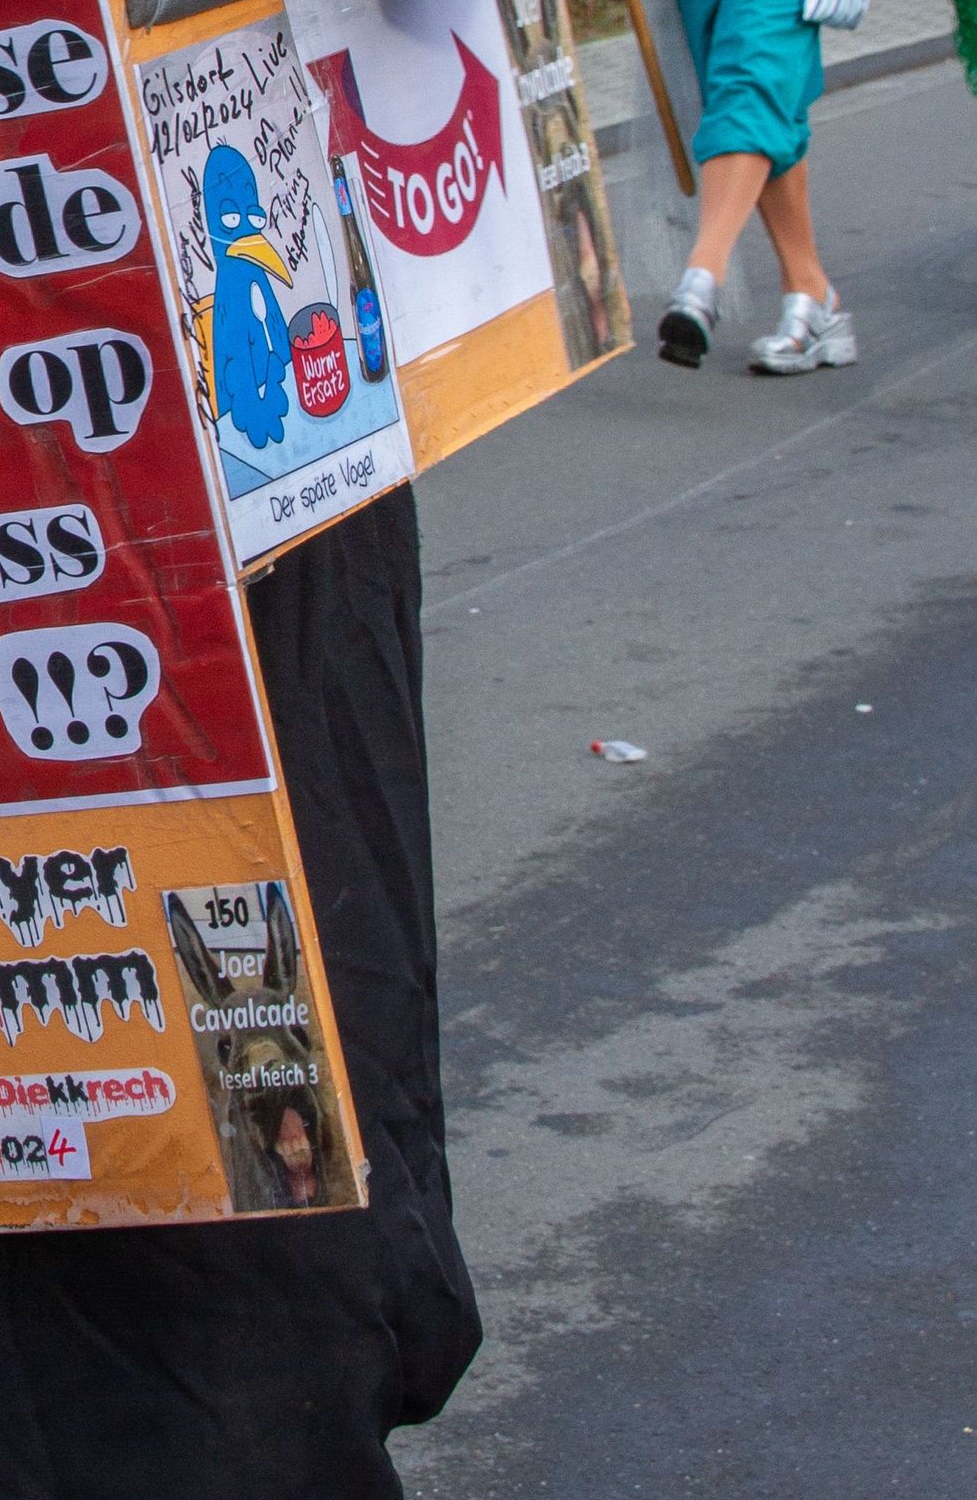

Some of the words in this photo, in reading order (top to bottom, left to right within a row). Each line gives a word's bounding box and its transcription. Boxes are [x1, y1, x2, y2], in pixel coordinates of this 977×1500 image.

[143, 48, 235, 116] Gilsdorf
[242, 32, 287, 96] Live
[151, 88, 254, 165] 12/02/2024
[387, 166, 435, 235] TO
[436, 110, 484, 225] GO!
[9, 337, 146, 440] op
[301, 350, 341, 381] Wurm-
[302, 369, 346, 408] Ersatz
[269, 494, 296, 523] Der
[300, 472, 338, 513] späte
[339, 449, 376, 488] Vogel
[12, 641, 149, 751] !!?
[204, 896, 249, 930] 150
[218, 950, 266, 979] Joer
[190, 995, 309, 1032] Cavalcade
[261, 1061, 304, 1088] heich
[308, 1063, 319, 1086] 3
